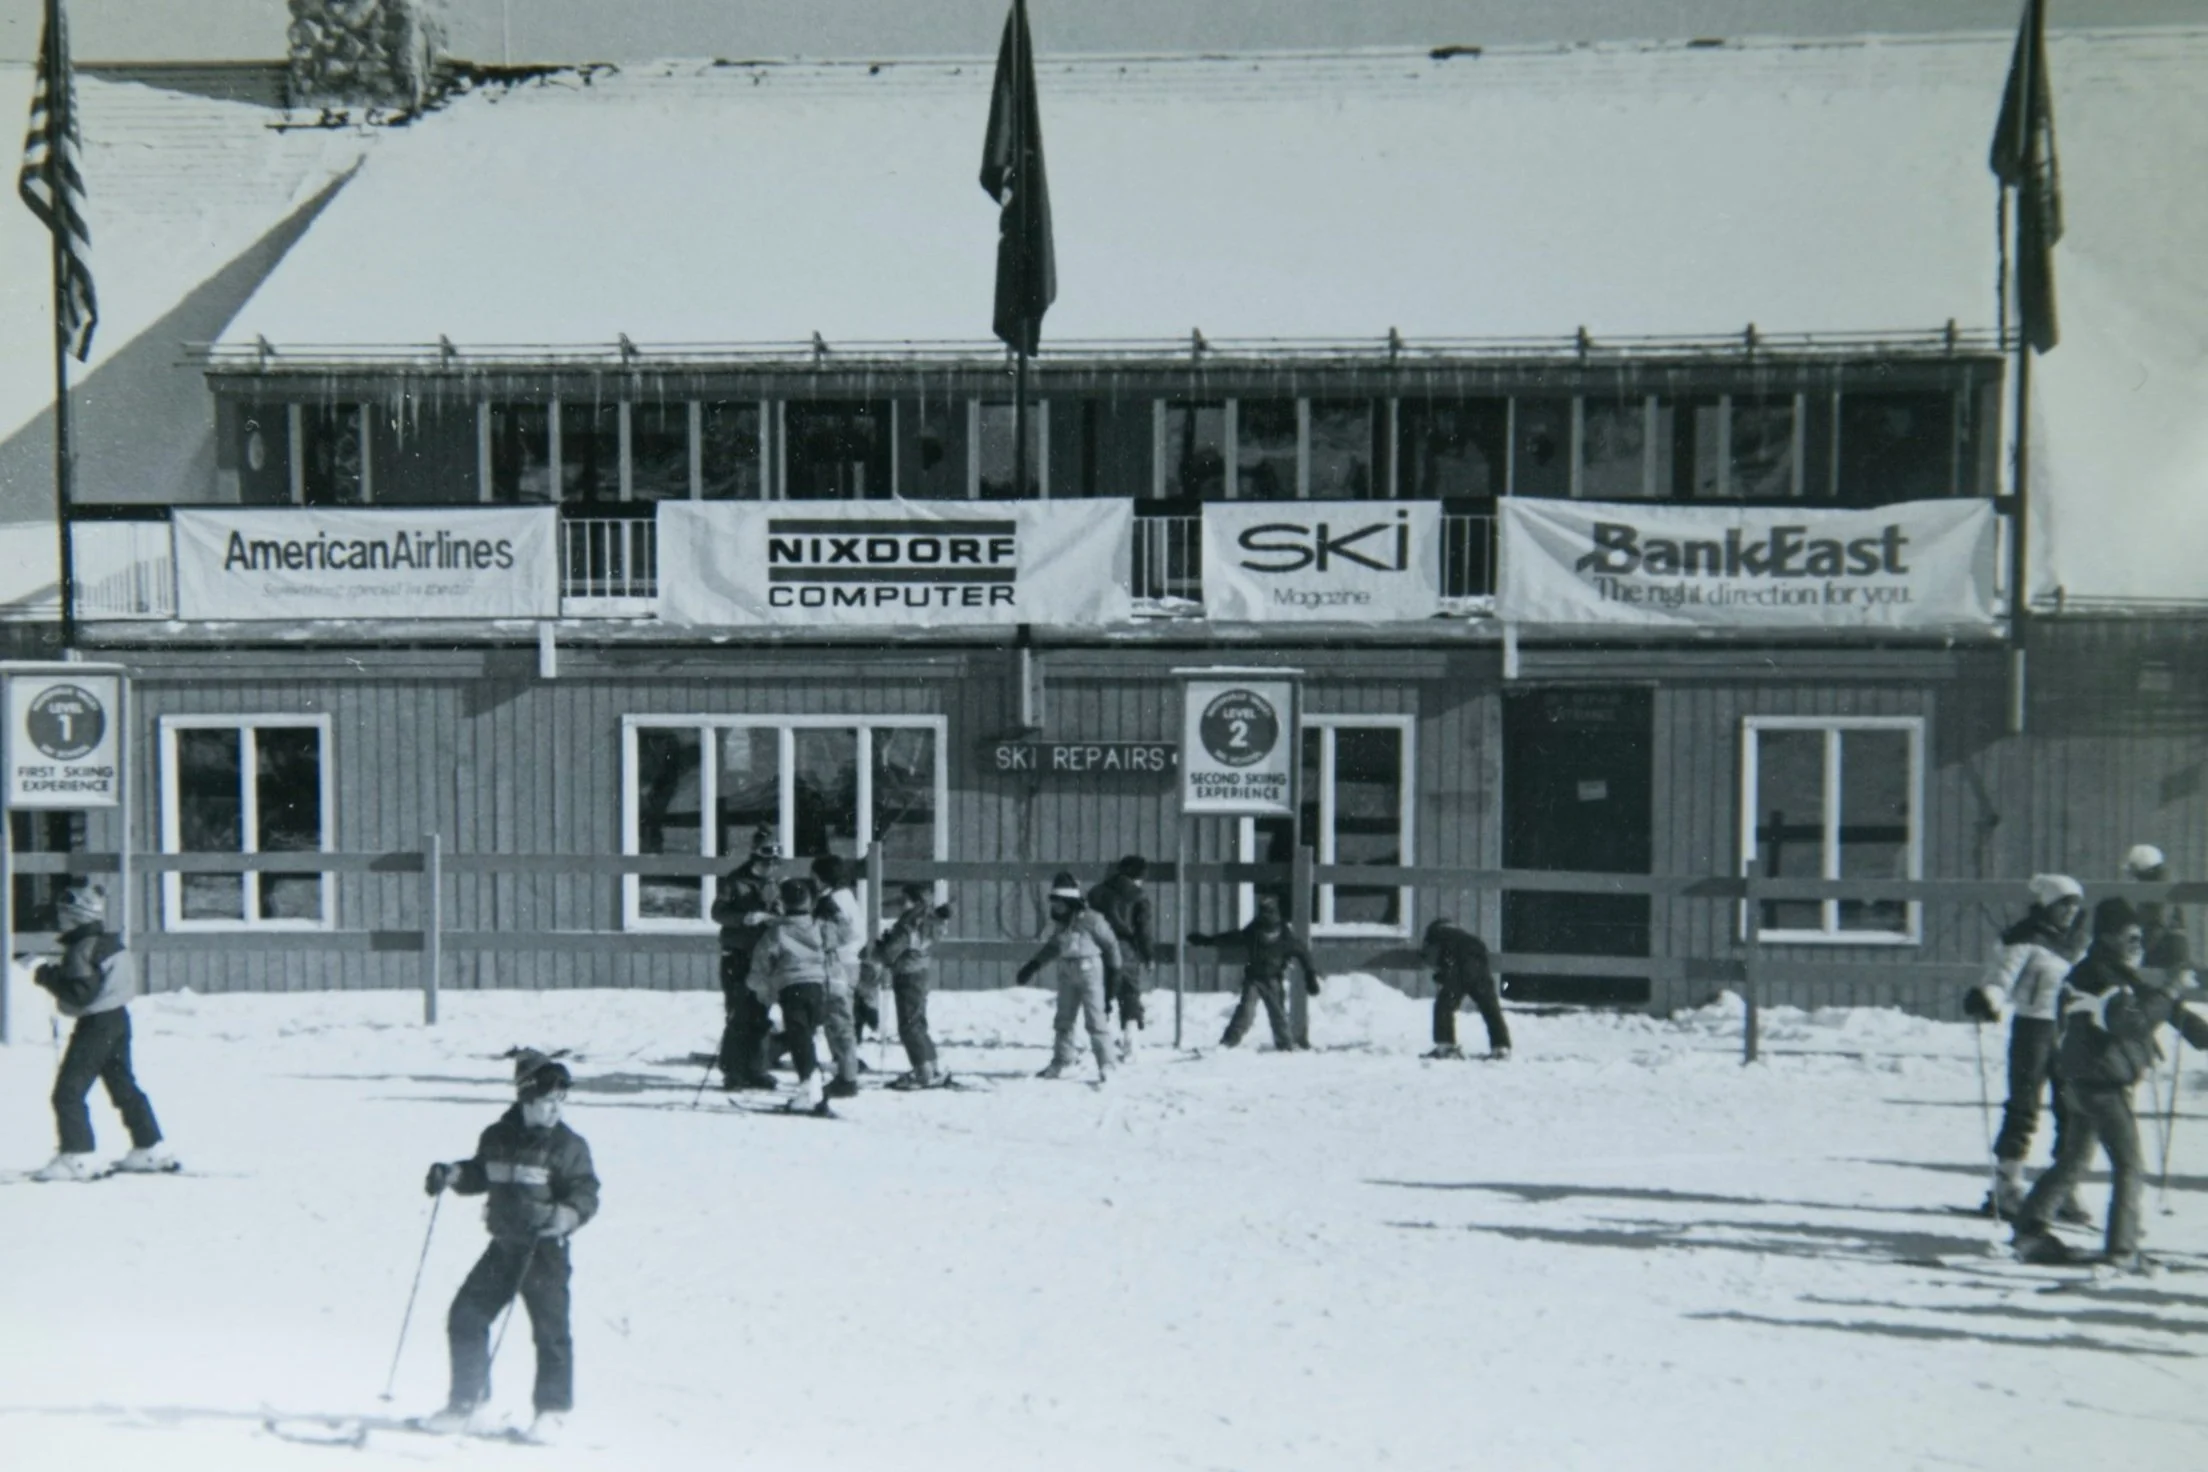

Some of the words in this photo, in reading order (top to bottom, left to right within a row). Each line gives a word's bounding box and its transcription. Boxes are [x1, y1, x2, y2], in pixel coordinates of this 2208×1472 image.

[224, 530, 514, 570] AmericanAirlines
[768, 538, 1015, 563] NIXDORF
[1576, 522, 1910, 578] BankEast
[768, 585, 1016, 608] COMPUTER
[1274, 588, 1371, 609] Magazine
[1593, 575, 1643, 603] The
[1648, 580, 1702, 609] right
[1708, 582, 1818, 606] direction
[1825, 580, 1854, 605] for
[58, 714, 72, 741] 1
[1229, 720, 1248, 747] 2
[996, 747, 1037, 770] SKI
[1053, 747, 1165, 771] REPAIRS
[18, 766, 55, 777] FIRST
[64, 766, 114, 777] SKIING
[1190, 772, 1240, 785] SECOND
[22, 780, 109, 792] EXPERIENCE
[1197, 786, 1280, 800] EXPERIENCE
